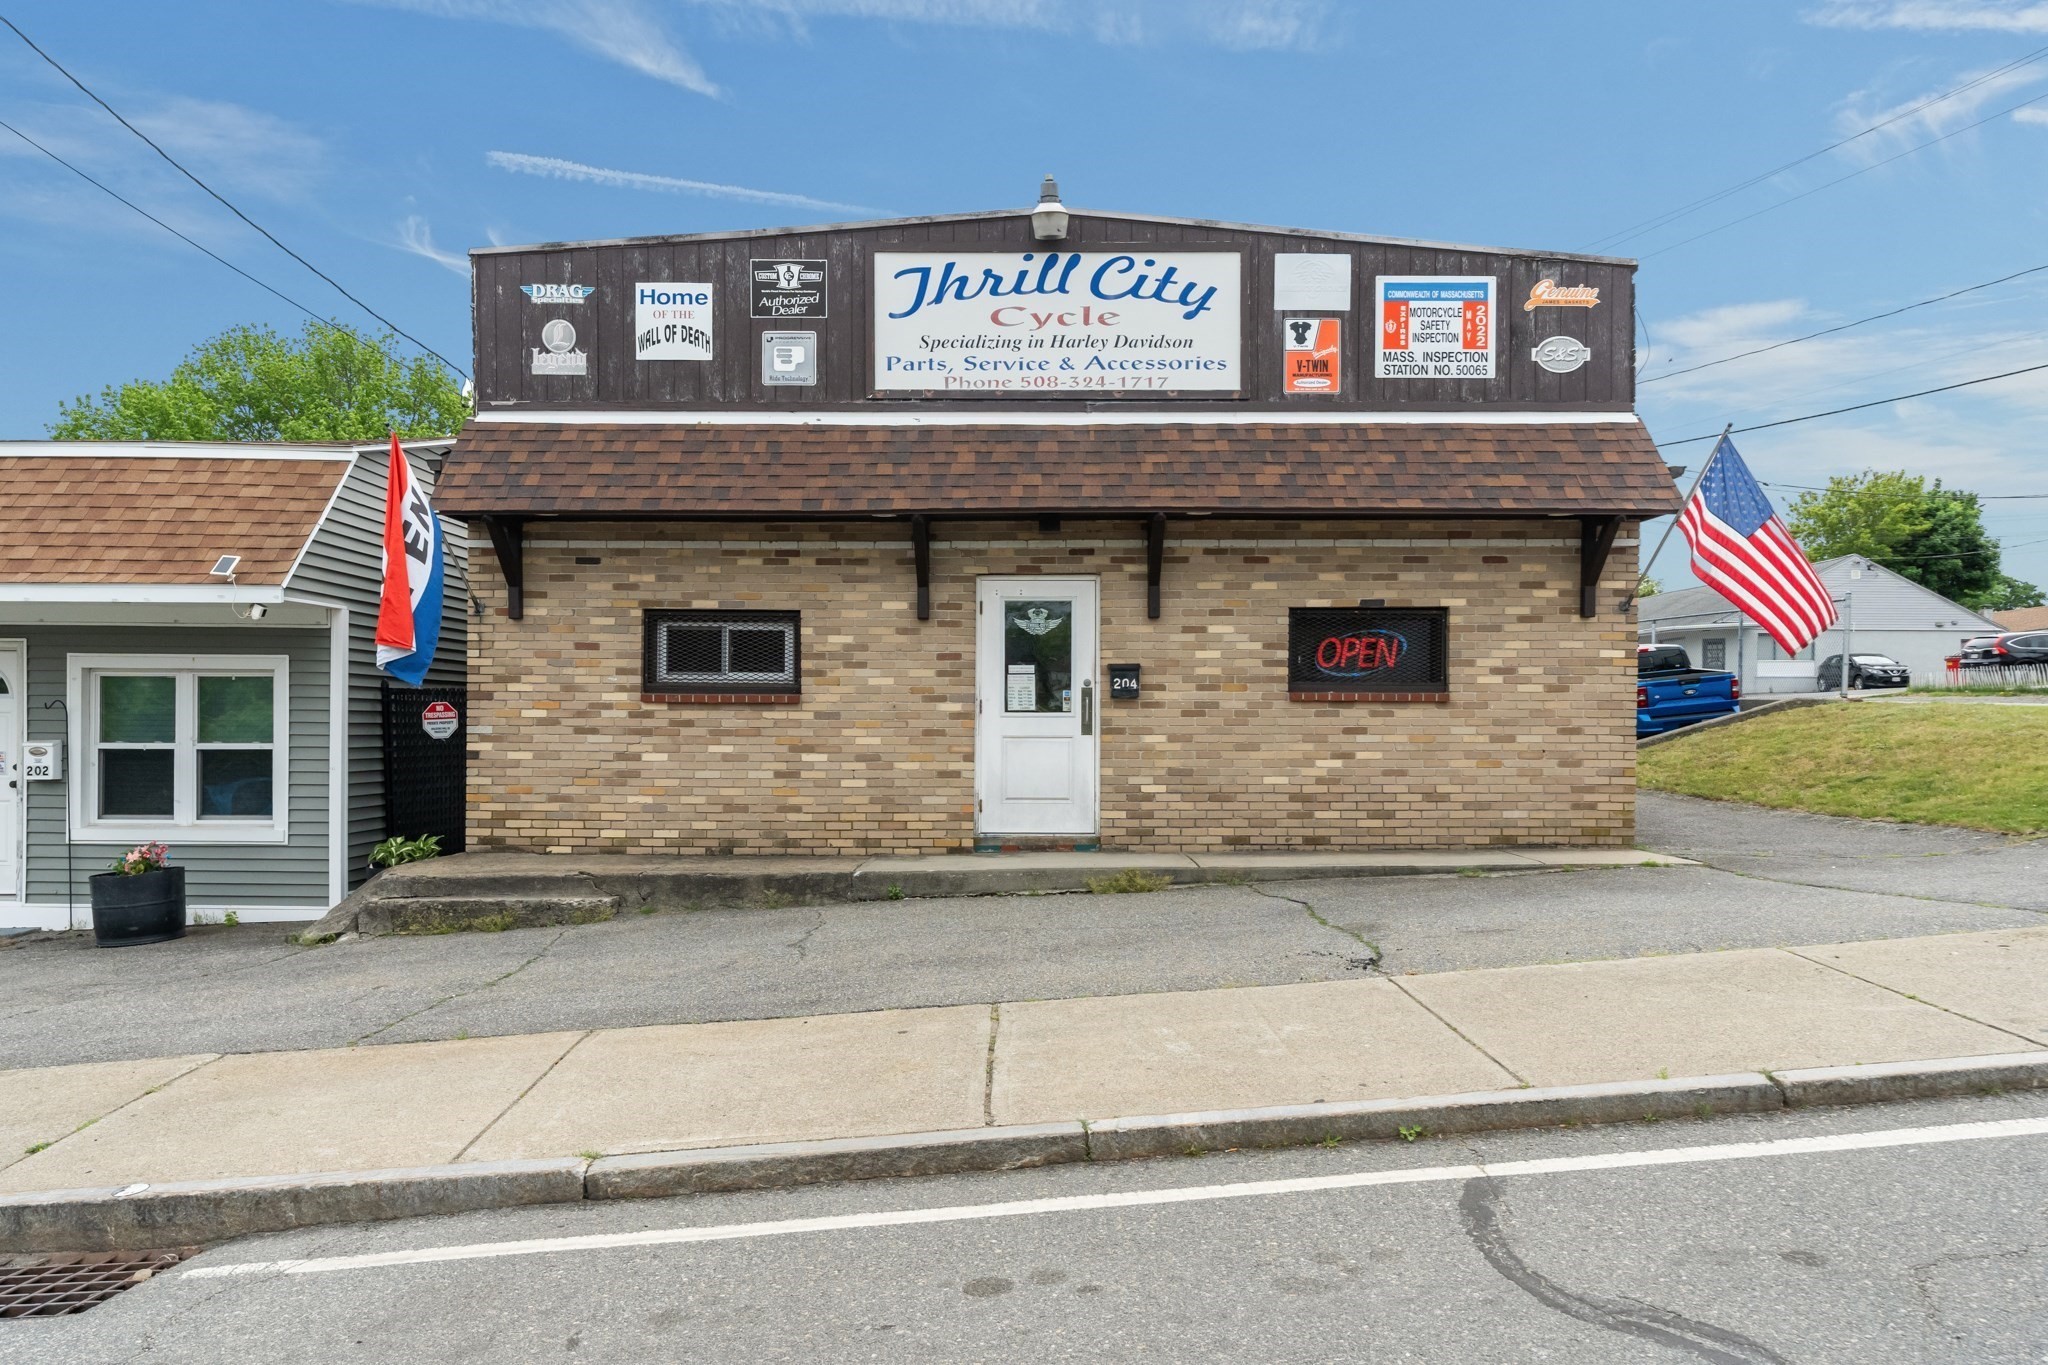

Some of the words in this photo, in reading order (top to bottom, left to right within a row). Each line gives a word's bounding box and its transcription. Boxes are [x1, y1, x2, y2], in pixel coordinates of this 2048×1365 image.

[532, 284, 583, 298] DRAG
[888, 253, 1082, 319] Thrill
[1090, 256, 1218, 320] City
[1528, 279, 1599, 301] Genuine
[640, 289, 708, 305] Home
[759, 292, 820, 307] Authorized
[1388, 290, 1430, 299] COMMONWEALTH
[1432, 290, 1440, 299] OF
[1441, 290, 1484, 299] MASSACHUSETTS
[653, 310, 668, 319] OF
[671, 310, 695, 319] THE
[772, 304, 808, 316] Dealer
[1410, 307, 1462, 318] MOTORCYCLE
[990, 305, 1121, 331] Cycle
[1420, 320, 1451, 331] SAFETY
[1476, 305, 1486, 346] 2022
[638, 326, 661, 353] WALL
[664, 324, 677, 344] OF
[681, 325, 711, 353] DEATH
[919, 334, 1022, 352] Specializing
[1028, 334, 1044, 349] in
[1050, 334, 1108, 351] Harley
[1114, 334, 1194, 349] Davidson
[1412, 332, 1459, 343] INSPECTION
[1383, 351, 1417, 363] MASS.
[1423, 351, 1488, 363] INSPECTION
[1542, 346, 1578, 362] S&S
[886, 356, 953, 374] Parts,
[964, 355, 1050, 371] Service
[1059, 356, 1075, 371] &
[1084, 355, 1227, 371] Accessories
[1296, 360, 1329, 372] V-TWIN
[1383, 364, 1428, 376] STATION
[1434, 364, 1453, 376] NO.
[1456, 364, 1488, 376] 50065
[944, 376, 1012, 389] Phone
[1021, 375, 1169, 389] 508-324-1717
[1316, 637, 1398, 668] OPEN
[1113, 678, 1138, 690] 204
[26, 766, 49, 776] 202
